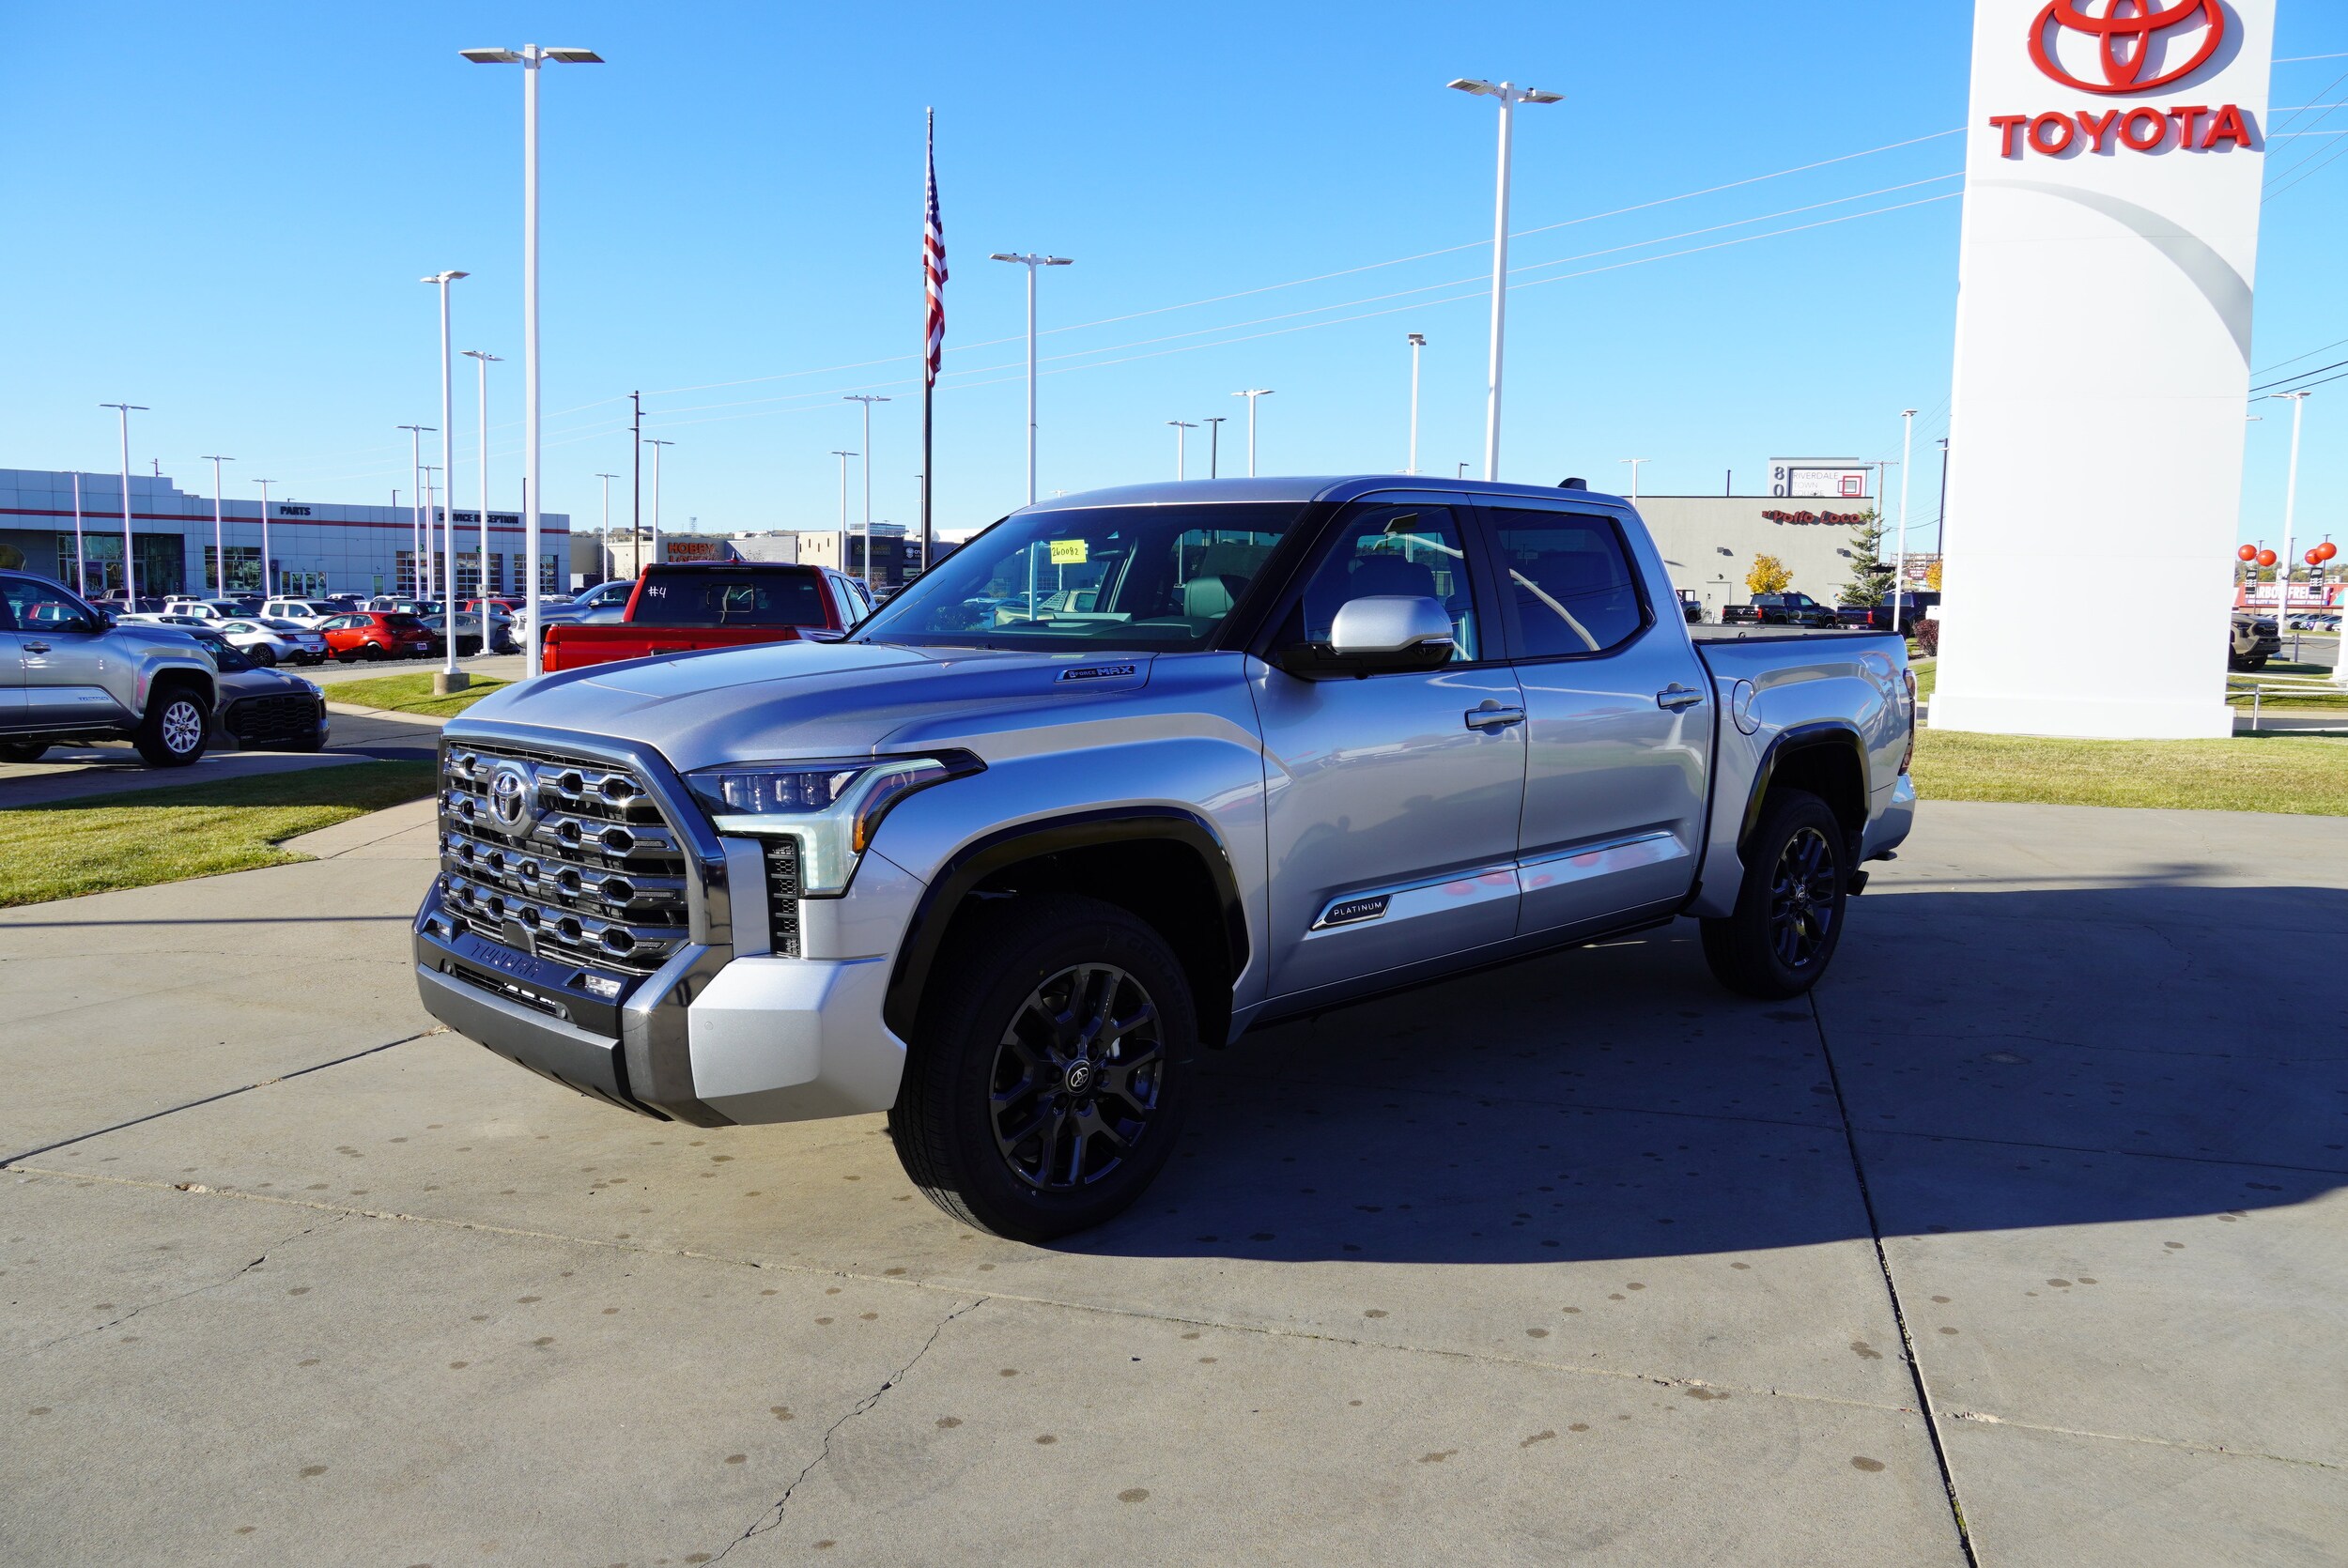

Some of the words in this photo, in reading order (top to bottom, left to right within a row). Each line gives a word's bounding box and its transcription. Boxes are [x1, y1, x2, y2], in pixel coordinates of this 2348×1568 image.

[1989, 104, 2252, 157] TOYOTA
[280, 506, 311, 515] PARTS
[1773, 510, 1814, 524] Pollo
[1819, 510, 1860, 524] Loco
[668, 543, 715, 554] HOBBY
[648, 586, 666, 598] #4
[1097, 667, 1132, 675] MAX
[1334, 901, 1382, 916] PLATINUM
[471, 943, 543, 978] TUNDRA
